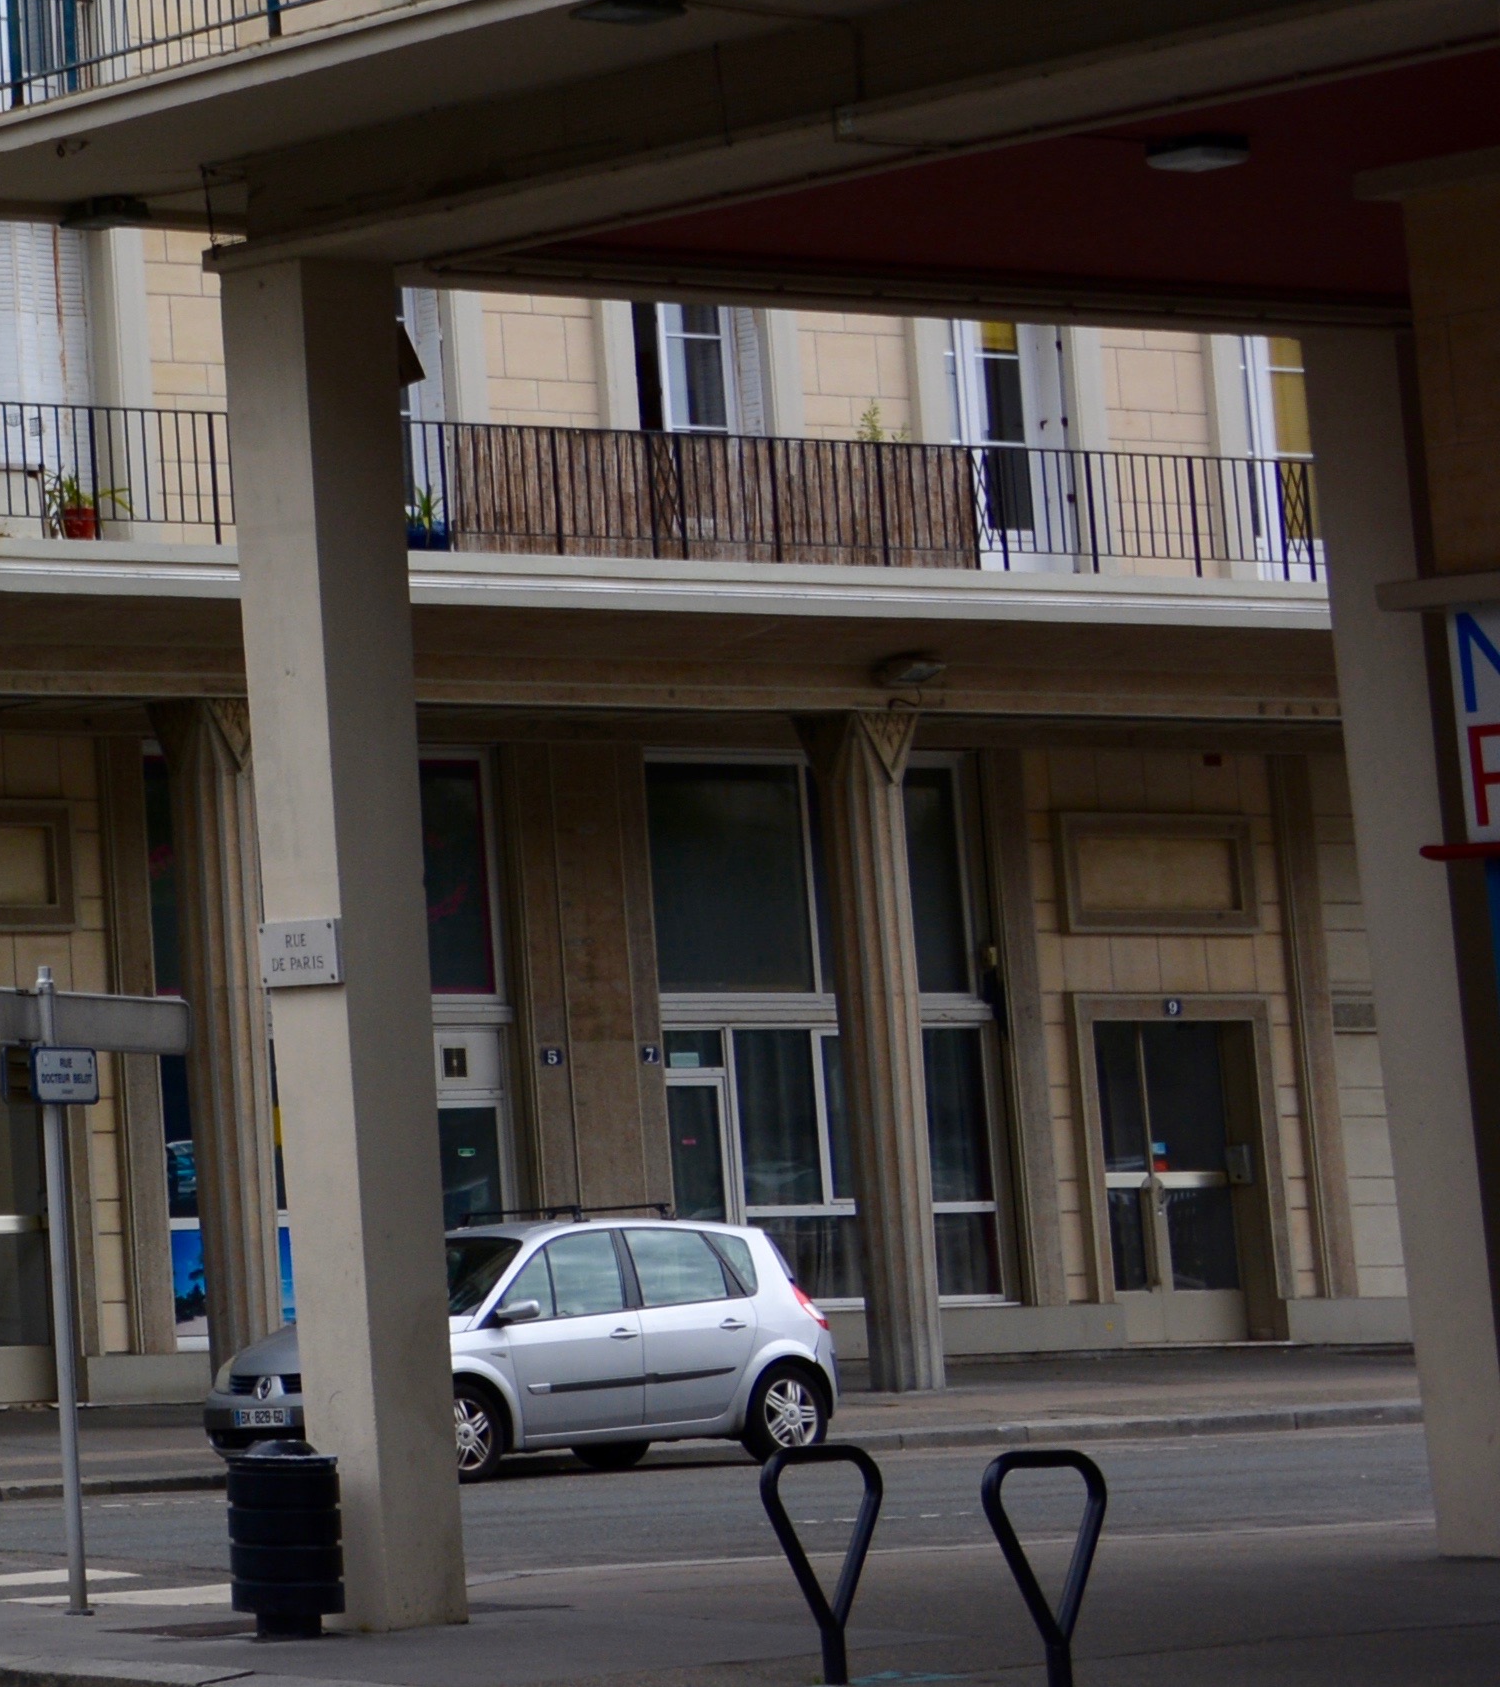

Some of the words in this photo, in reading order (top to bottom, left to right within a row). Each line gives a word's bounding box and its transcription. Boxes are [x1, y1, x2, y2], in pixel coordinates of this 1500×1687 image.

[285, 933, 307, 948] RUE
[272, 957, 286, 972] DE
[290, 955, 324, 971] PARIS
[1168, 1001, 1178, 1015] 9
[547, 1050, 558, 1065] 5
[645, 1047, 654, 1062] 7
[59, 1057, 73, 1069] RUE
[41, 1073, 70, 1084] DOCTEUR
[72, 1072, 93, 1084] BELOT
